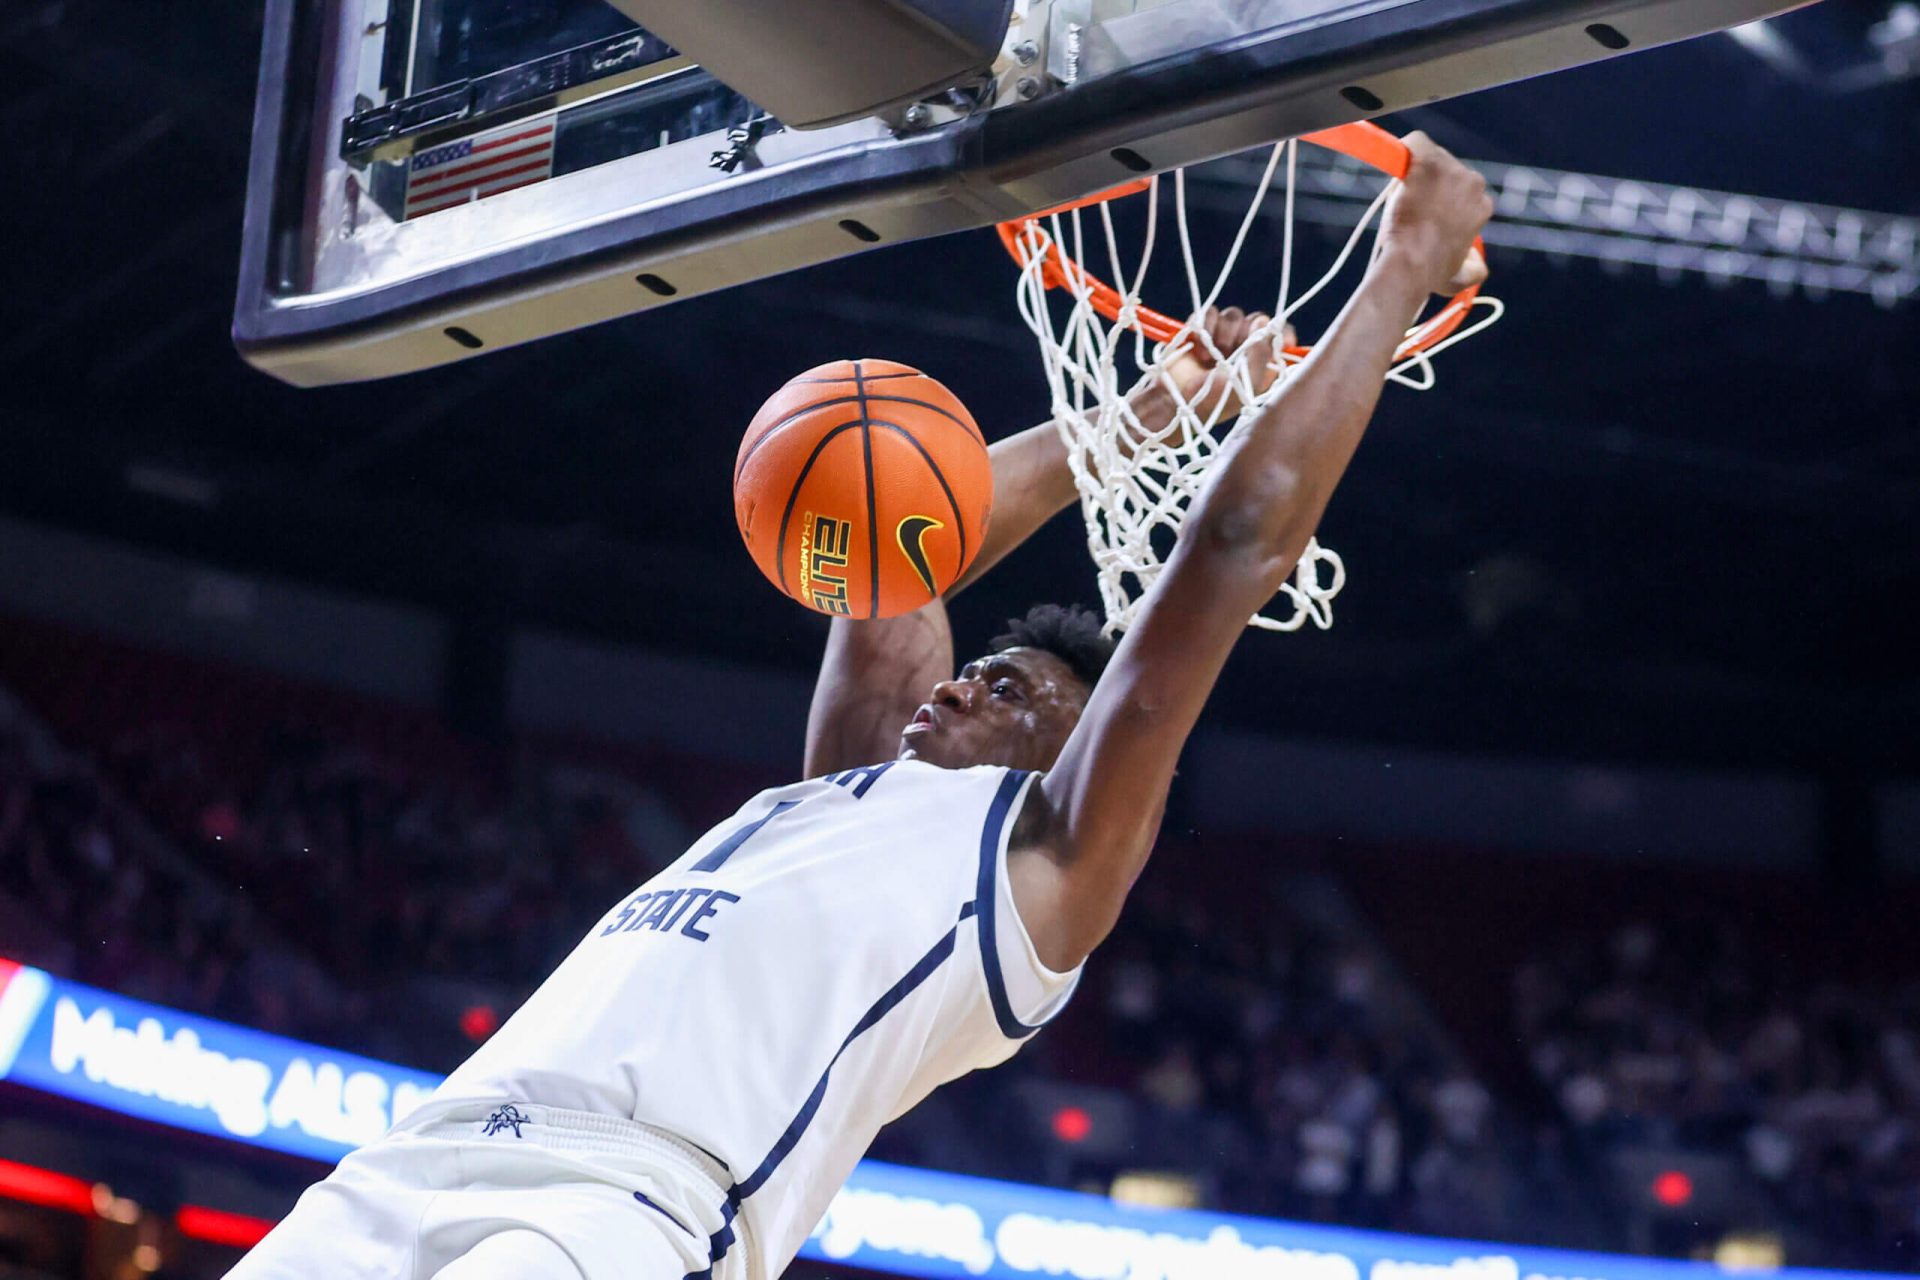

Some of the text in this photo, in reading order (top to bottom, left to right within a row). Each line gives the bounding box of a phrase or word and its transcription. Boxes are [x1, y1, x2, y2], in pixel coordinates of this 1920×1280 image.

[810, 513, 853, 617] ELITE
[600, 887, 741, 942] STATE
[50, 997, 272, 1137] Making
[270, 1059, 391, 1147] ALS
